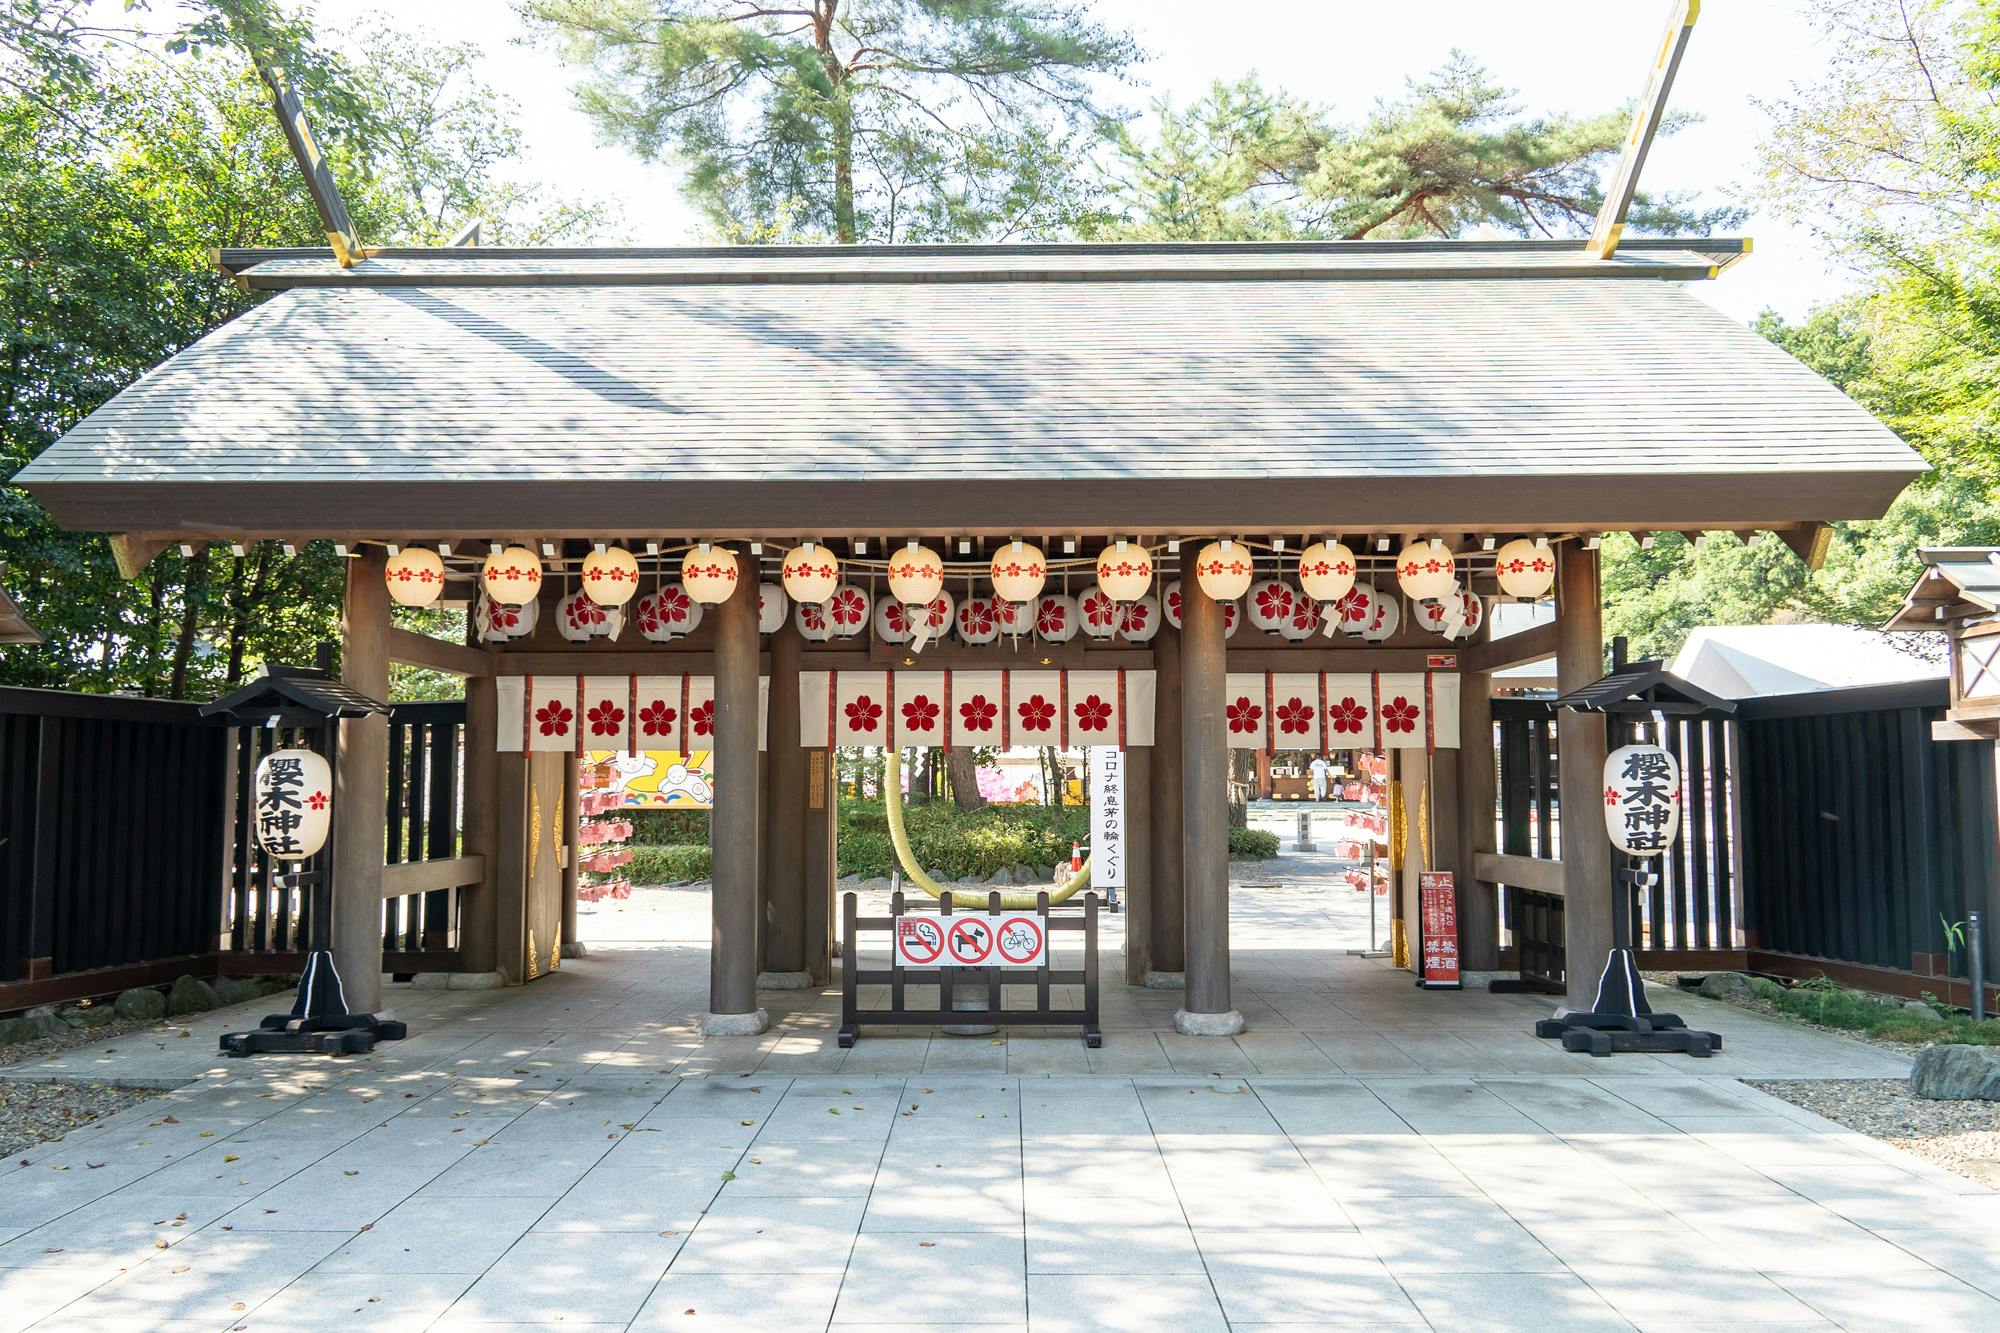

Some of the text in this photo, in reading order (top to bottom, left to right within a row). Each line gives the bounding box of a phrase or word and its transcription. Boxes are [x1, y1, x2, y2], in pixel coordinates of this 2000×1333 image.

[258, 758, 304, 855] 櫻木神社
[1104, 750, 1119, 879] コロナ終息茅の輪くぐり
[1621, 753, 1671, 850] 櫻木神社
[1422, 875, 1453, 888] 禁止
